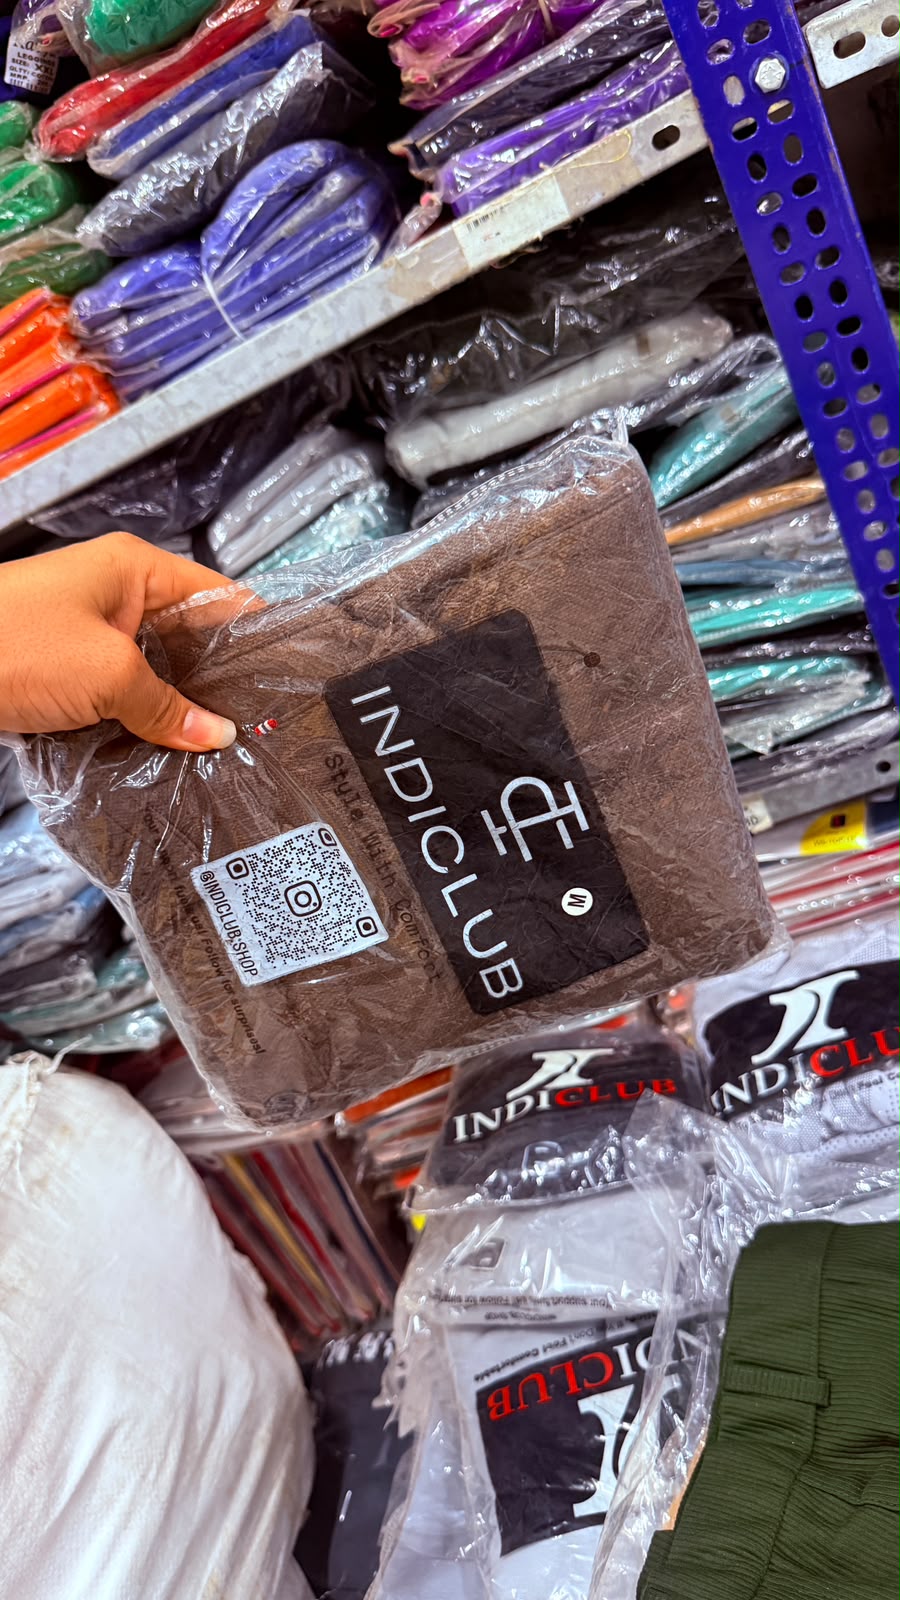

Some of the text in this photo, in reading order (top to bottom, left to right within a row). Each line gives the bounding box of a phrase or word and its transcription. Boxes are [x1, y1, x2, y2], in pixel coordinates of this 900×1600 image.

[325, 754, 442, 984] Style With Comfort
[351, 685, 524, 1000] INDICLUB
[200, 870, 259, 977] @INDICLUB.SHOP
[567, 893, 587, 908] M
[201, 939, 225, 977] Follow
[222, 980, 236, 995] for
[452, 1078, 678, 1144] INDICLUB
